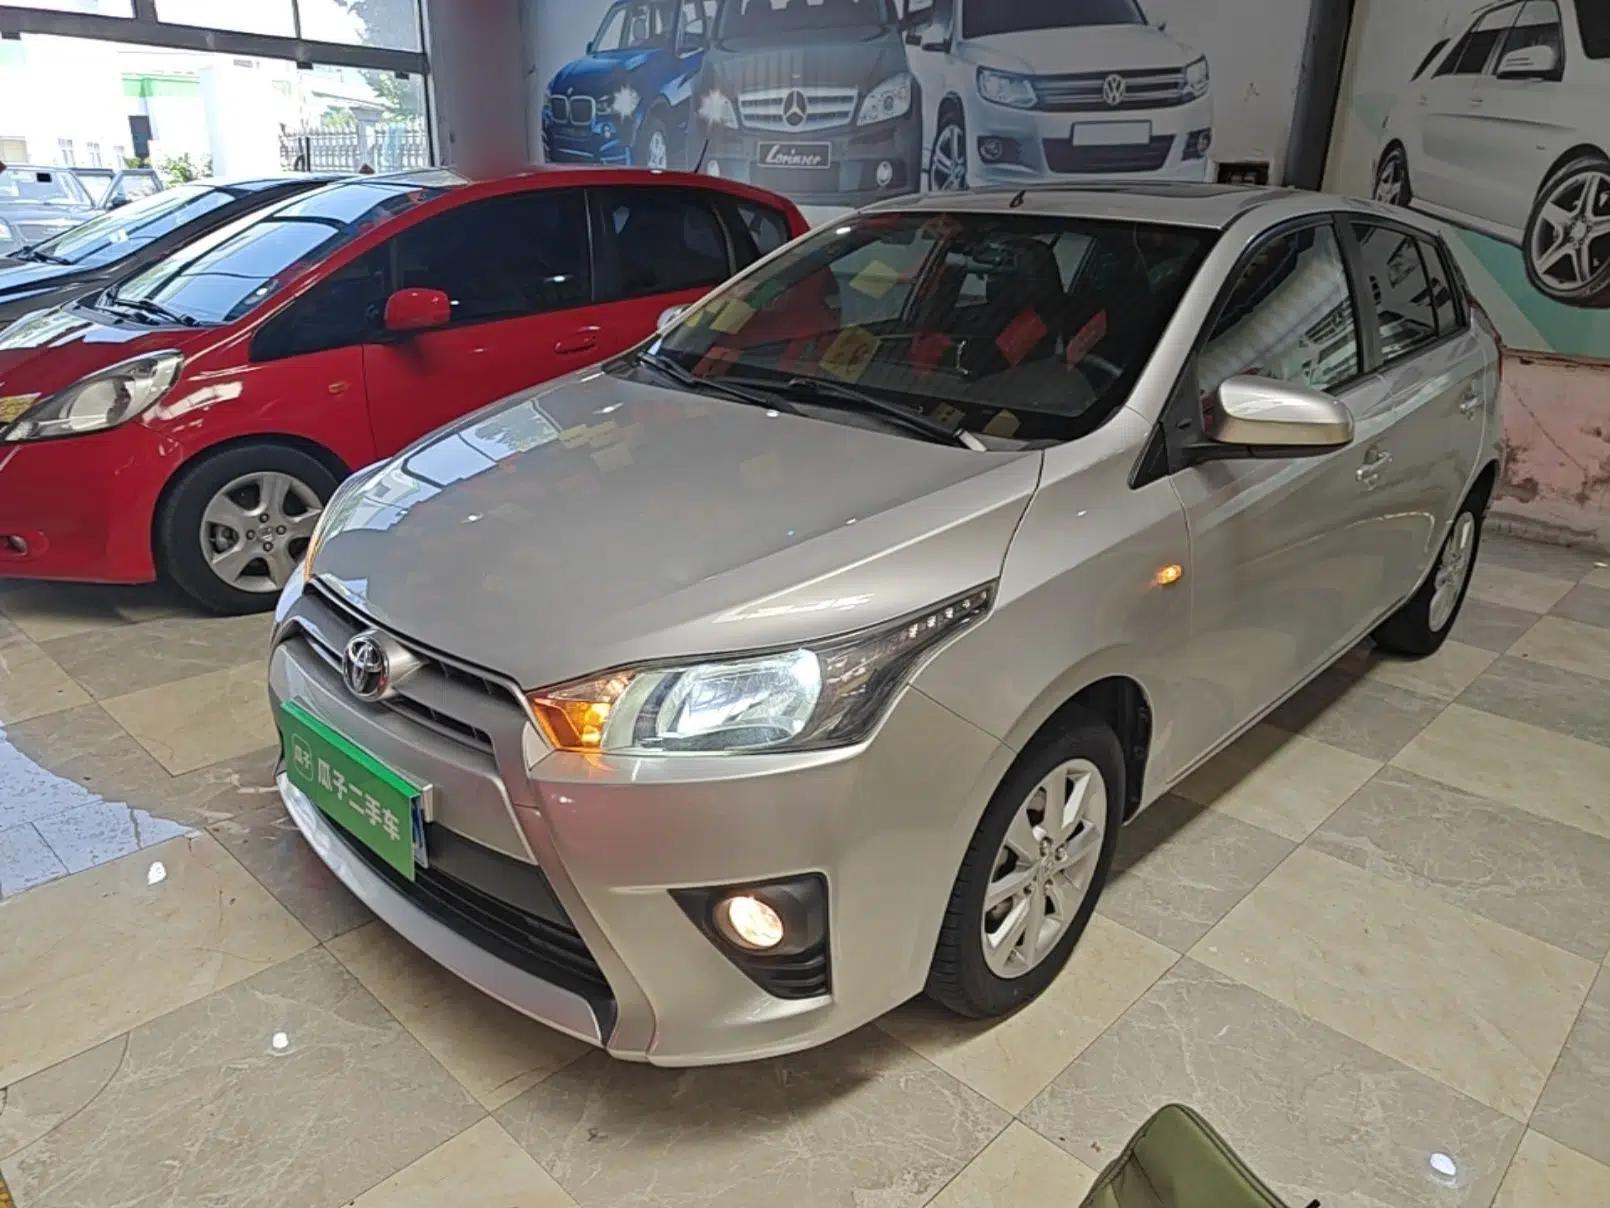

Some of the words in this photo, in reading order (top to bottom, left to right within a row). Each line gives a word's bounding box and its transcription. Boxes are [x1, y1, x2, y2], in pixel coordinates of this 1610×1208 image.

[318, 758, 400, 841] 瓜子二手车
